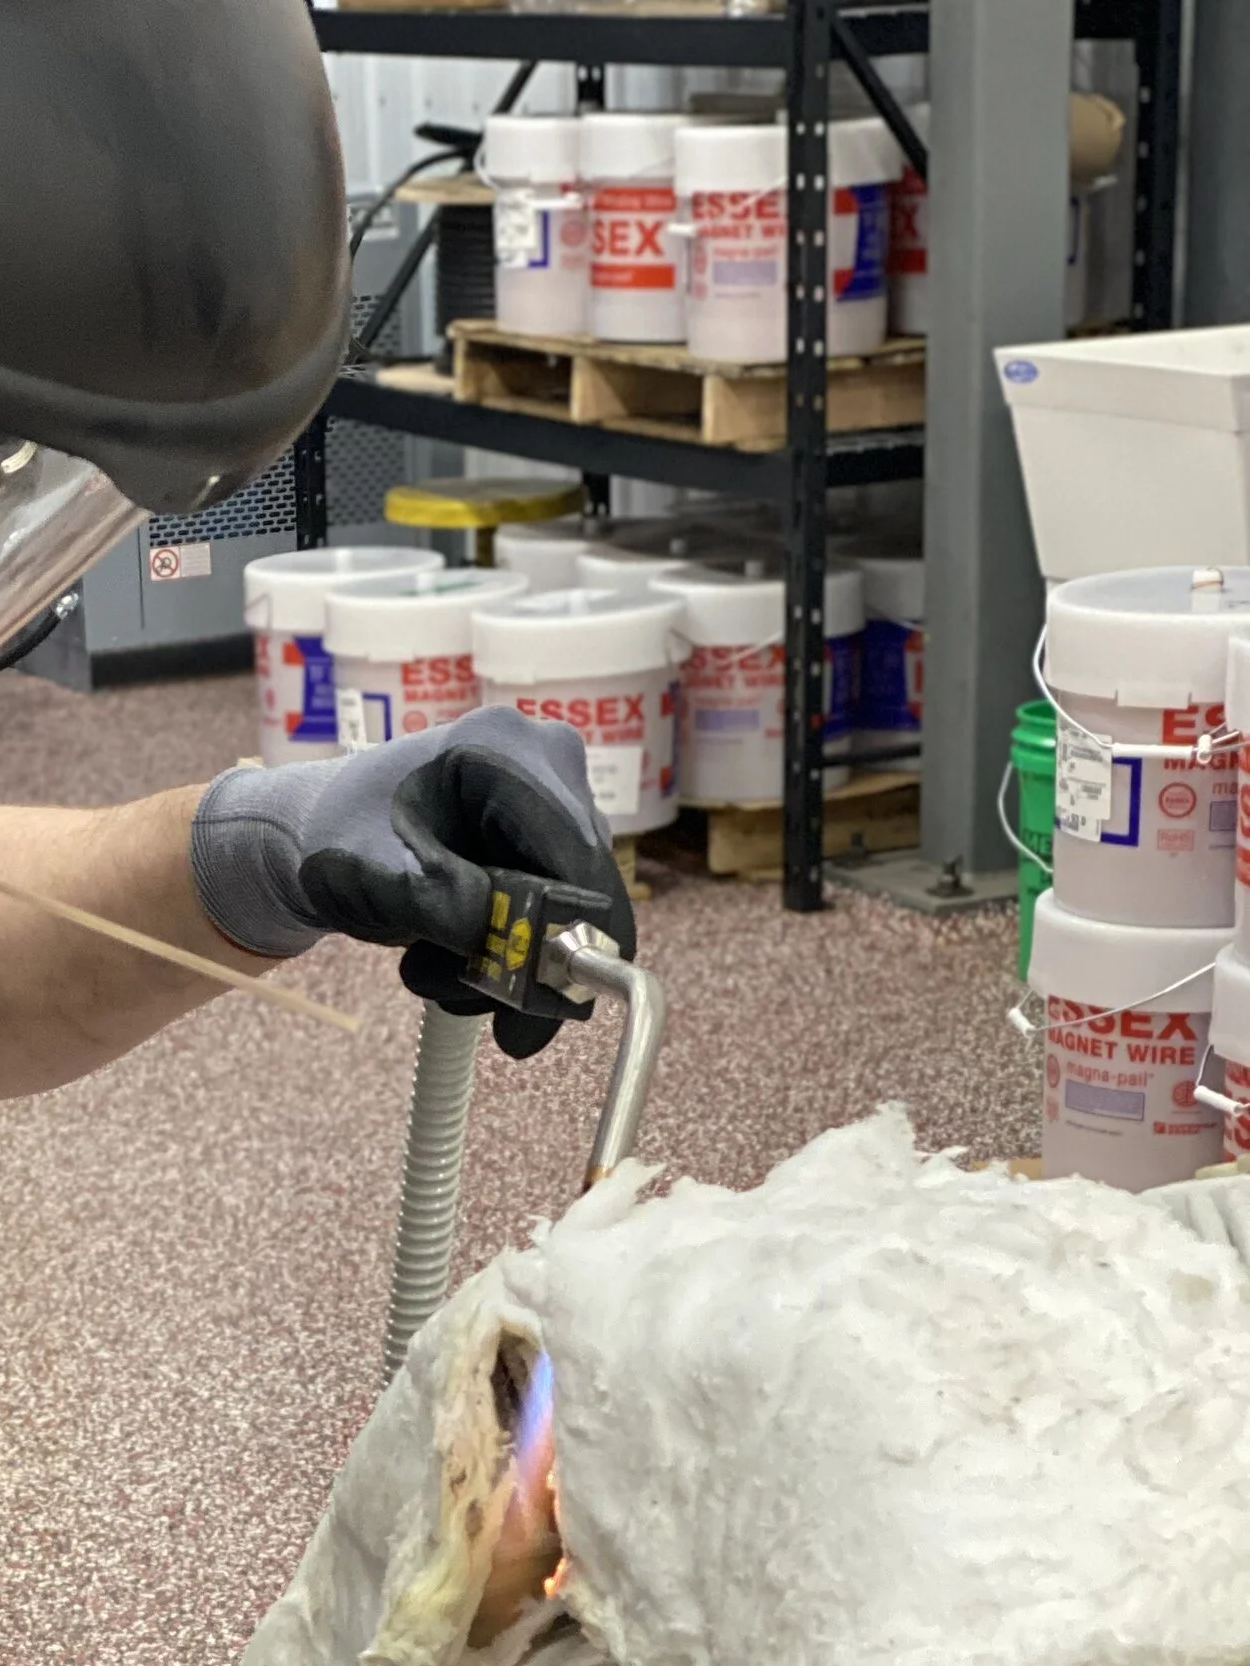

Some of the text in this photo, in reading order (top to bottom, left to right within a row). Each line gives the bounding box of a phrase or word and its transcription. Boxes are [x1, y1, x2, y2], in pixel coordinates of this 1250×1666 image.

[692, 190, 786, 219] ESSE
[592, 219, 664, 256] SEX
[401, 654, 474, 685] ESS
[517, 694, 643, 728] ESSEX
[1127, 1043, 1196, 1066] WIRE
